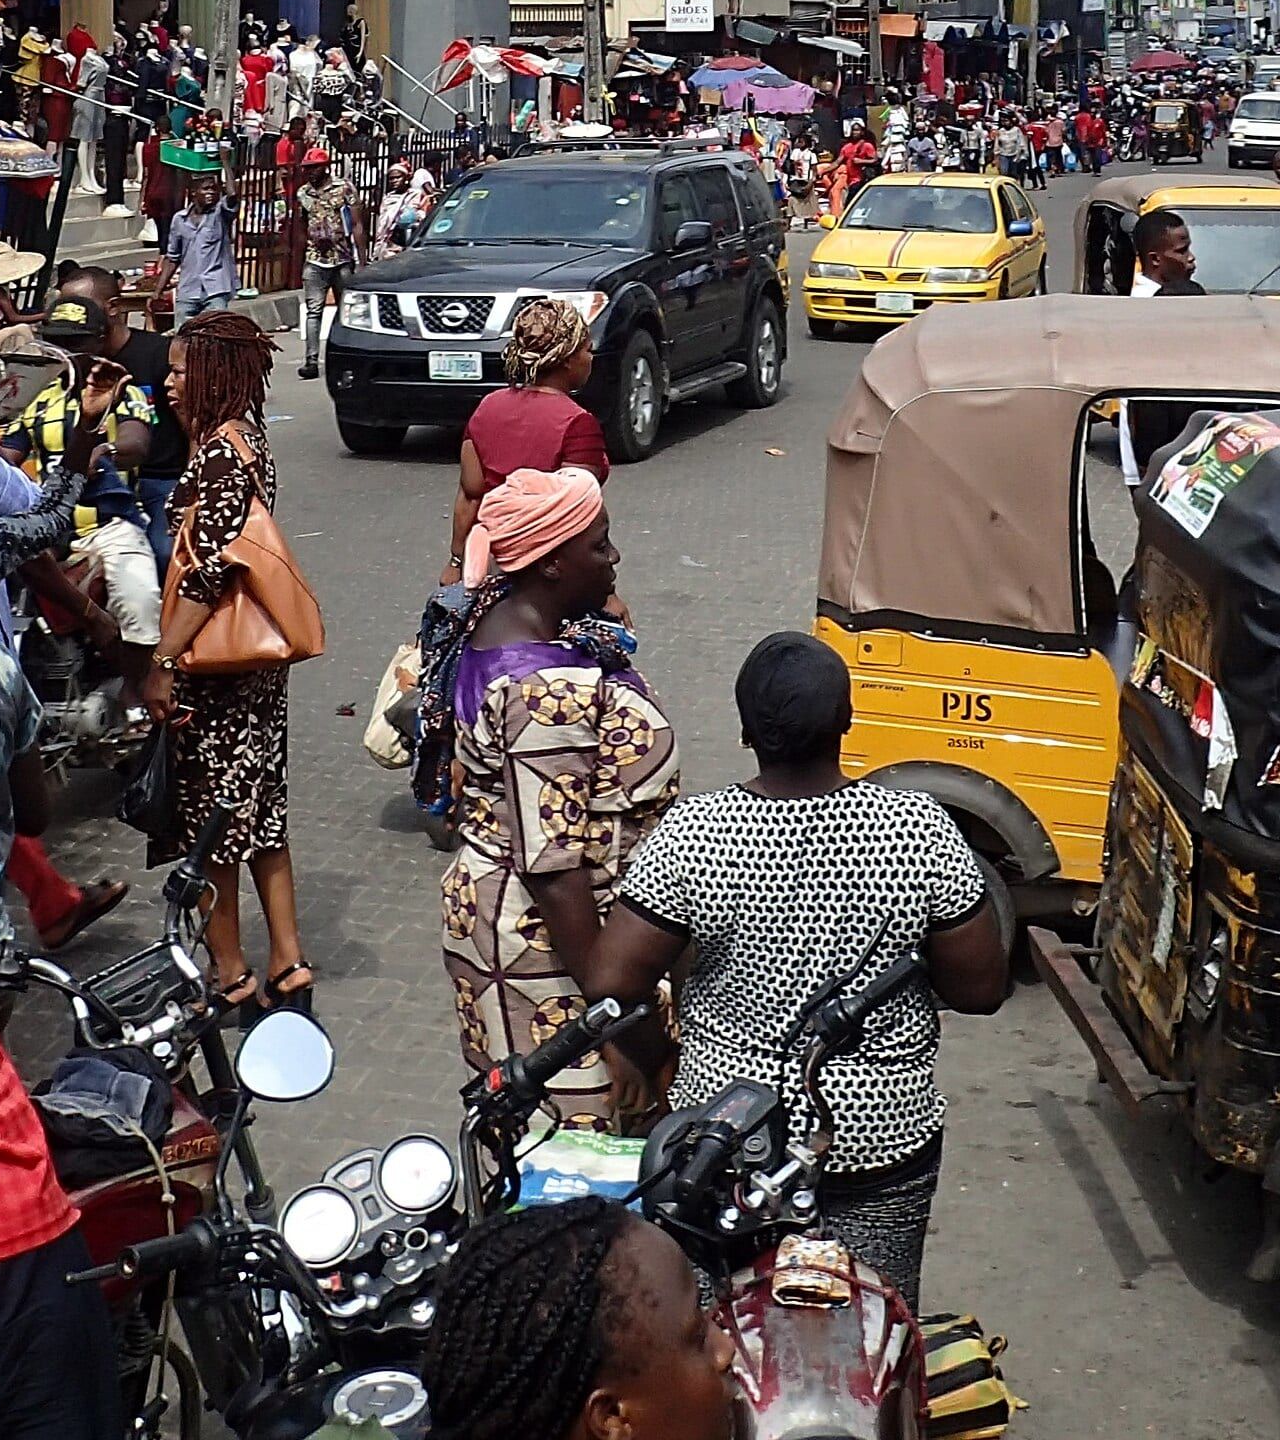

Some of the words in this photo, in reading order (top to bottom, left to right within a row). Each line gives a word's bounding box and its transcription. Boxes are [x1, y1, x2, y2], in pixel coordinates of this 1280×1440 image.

[671, 6, 708, 14] SHOES
[942, 692, 992, 722] PJS
[948, 736, 985, 749] assist
